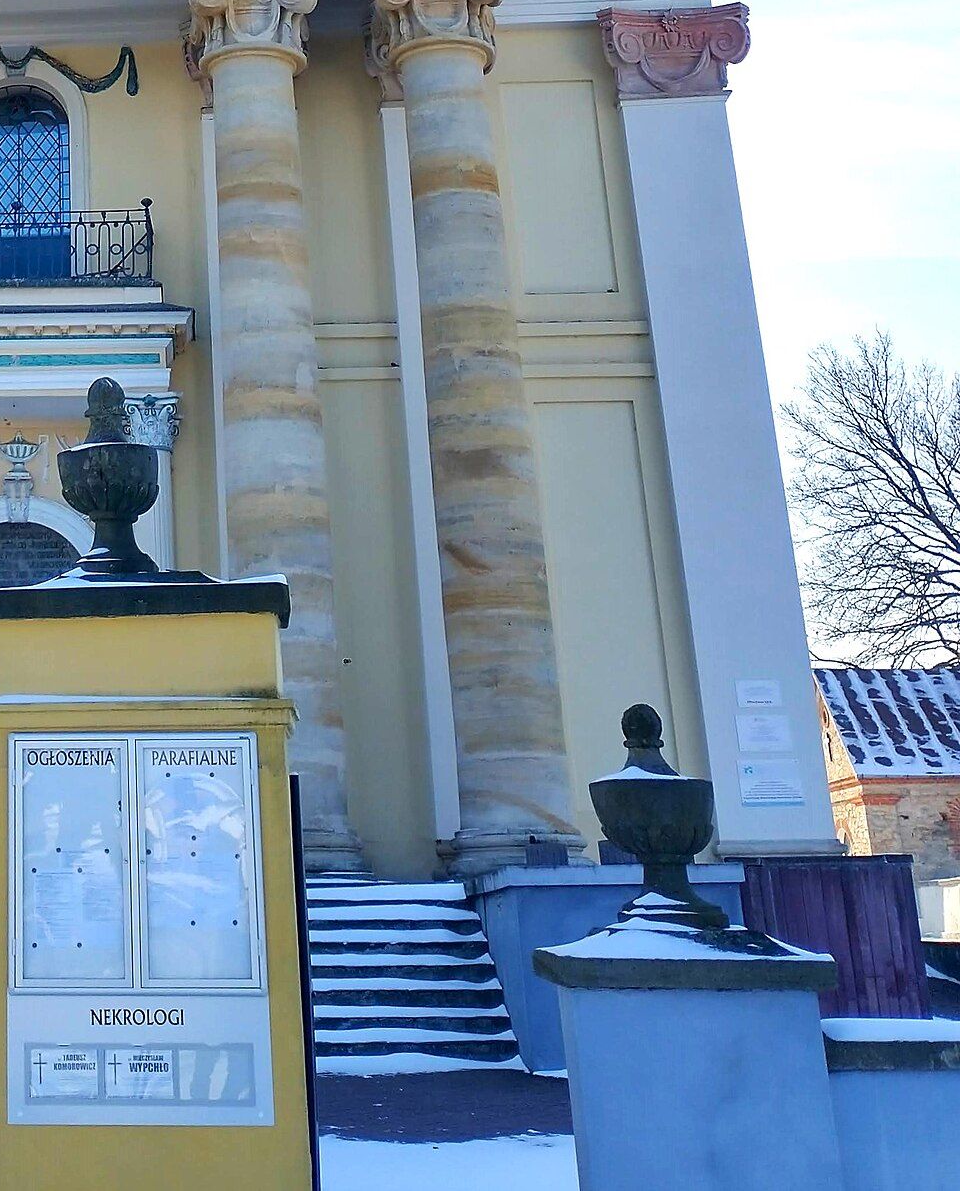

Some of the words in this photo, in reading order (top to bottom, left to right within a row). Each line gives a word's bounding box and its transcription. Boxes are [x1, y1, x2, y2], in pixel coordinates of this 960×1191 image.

[27, 750, 115, 766] OGŁOSZENIA
[151, 750, 237, 766] PARAFIALNE
[90, 1009, 184, 1026] NEKROLOGI
[53, 1062, 96, 1071] KOMOROWICZ
[129, 1062, 169, 1073] WYPCHŁO
